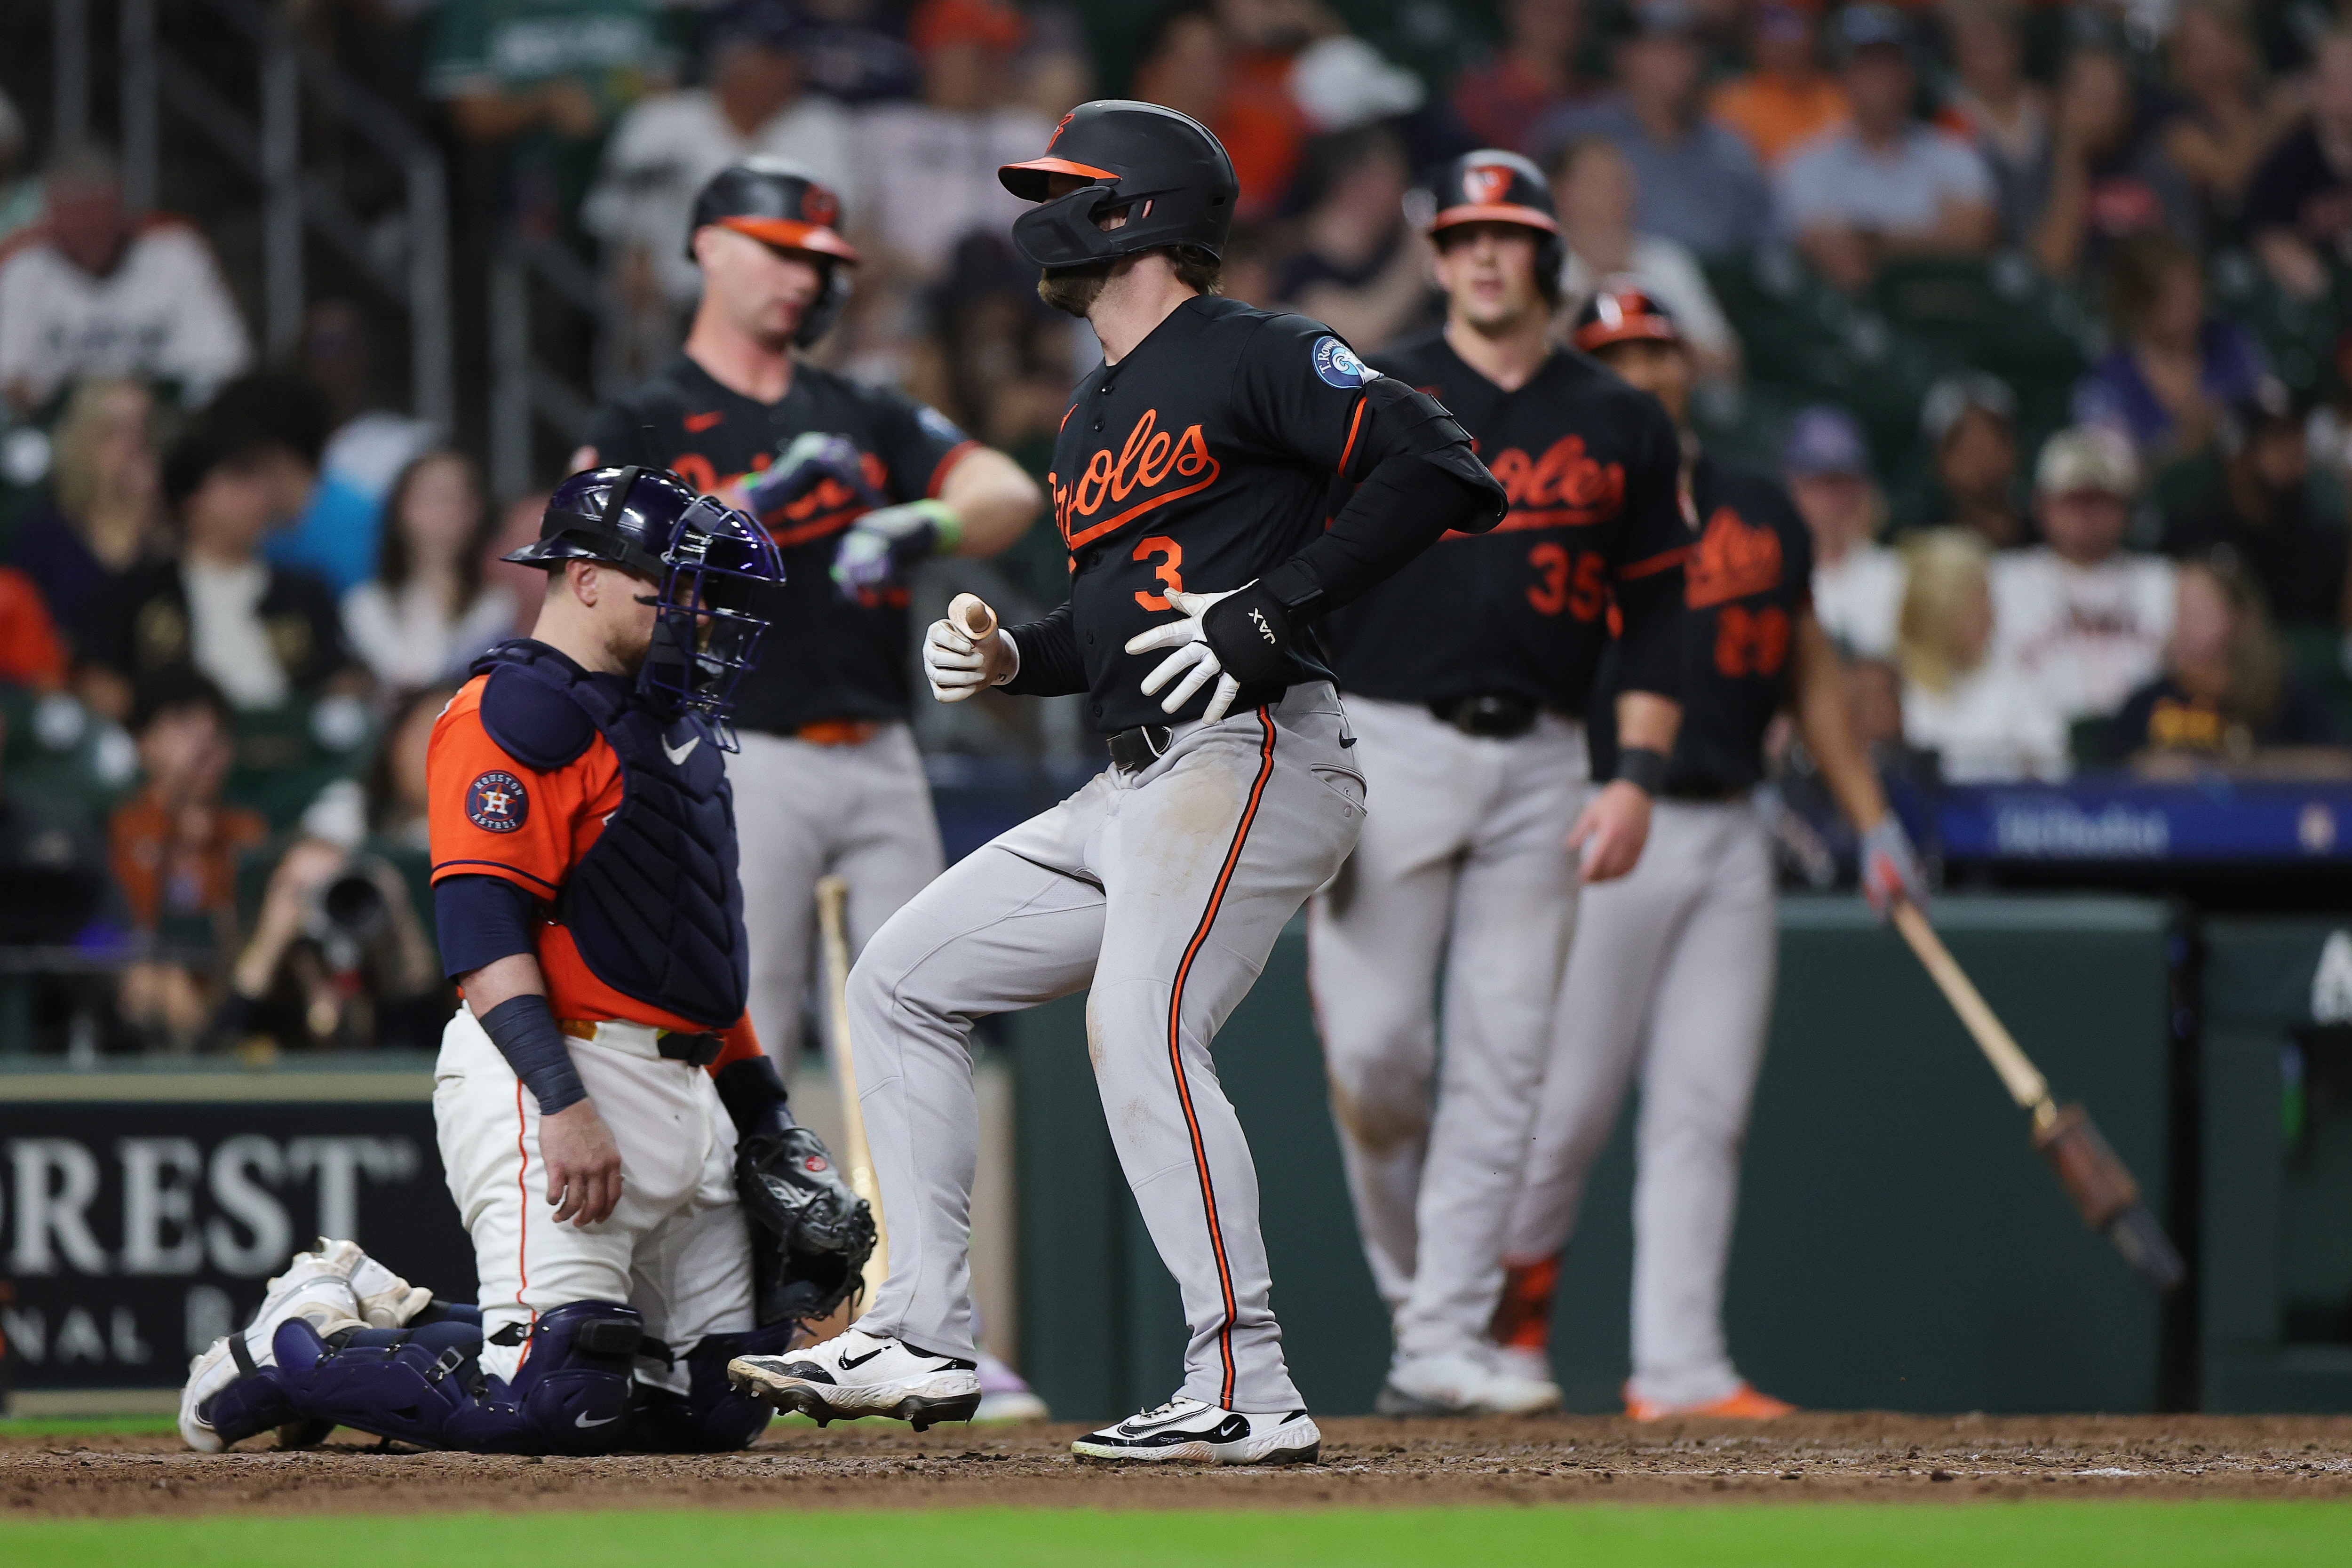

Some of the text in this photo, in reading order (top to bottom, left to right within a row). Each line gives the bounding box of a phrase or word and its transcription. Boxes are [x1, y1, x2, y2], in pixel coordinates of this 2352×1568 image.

[1133, 535, 1183, 612] 3
[1526, 540, 1605, 622] 35
[1248, 607, 1276, 645] JAX
[474, 774, 524, 796] HOUSTON
[472, 813, 516, 829] ASTROS
[0, 1134, 386, 1277] REST
